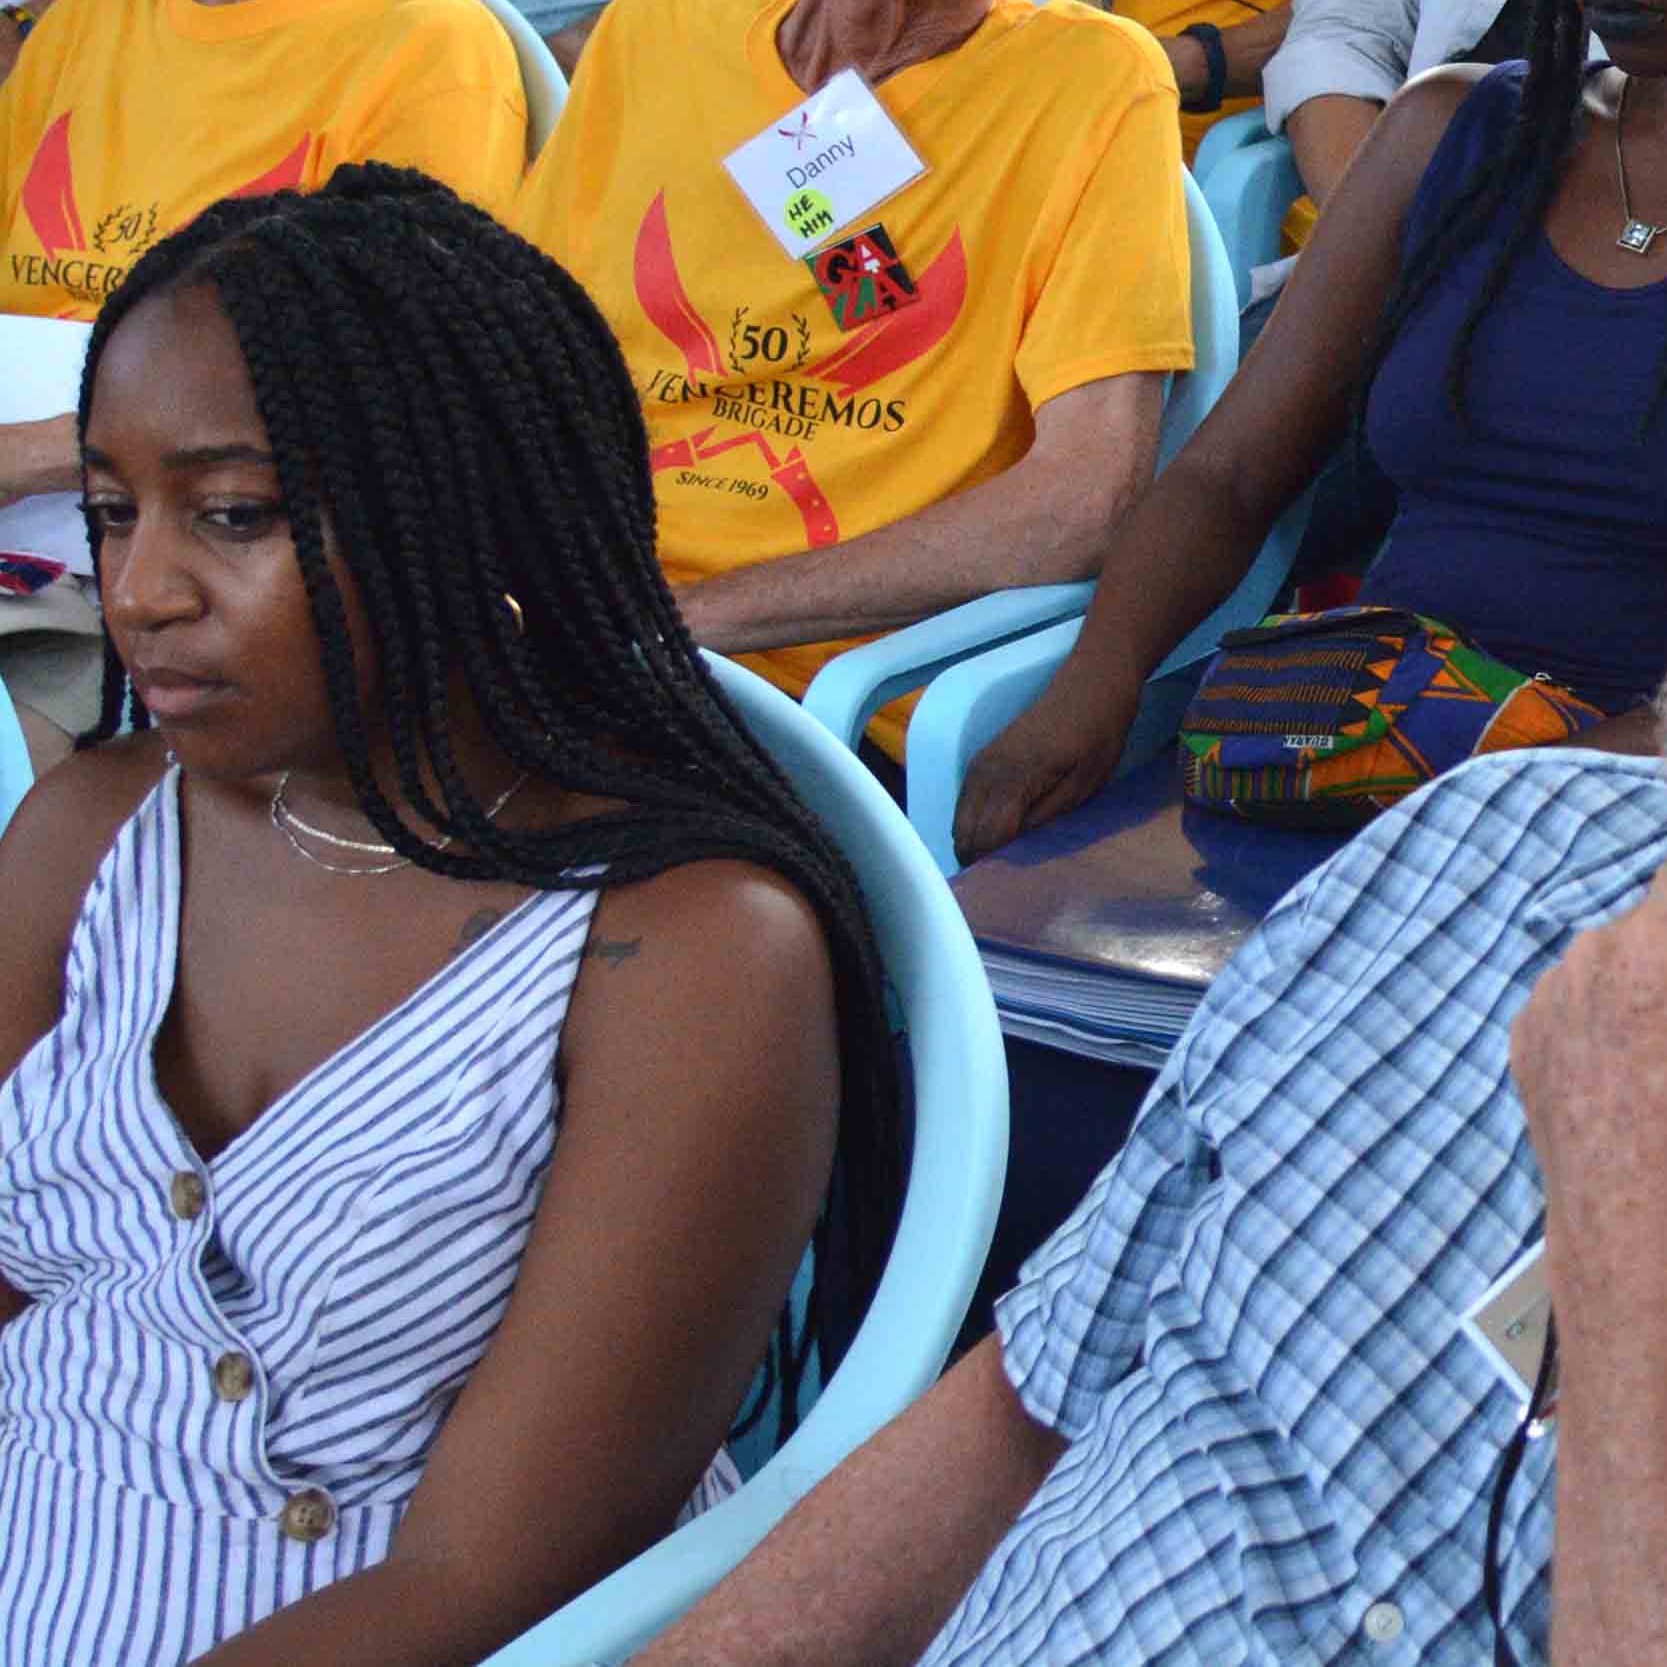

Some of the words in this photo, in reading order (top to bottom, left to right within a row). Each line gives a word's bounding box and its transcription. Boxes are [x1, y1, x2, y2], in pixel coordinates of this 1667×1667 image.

[785, 134, 856, 190] Danny
[110, 210, 142, 243] 50
[787, 194, 815, 222] HE
[799, 209, 835, 239] HIM
[10, 253, 128, 295] VENCER
[739, 325, 789, 362] 50
[646, 369, 907, 433] VENCEREMOS
[711, 396, 819, 442] BRIGADE
[675, 470, 725, 490] SINCE
[728, 478, 769, 501] 1969
